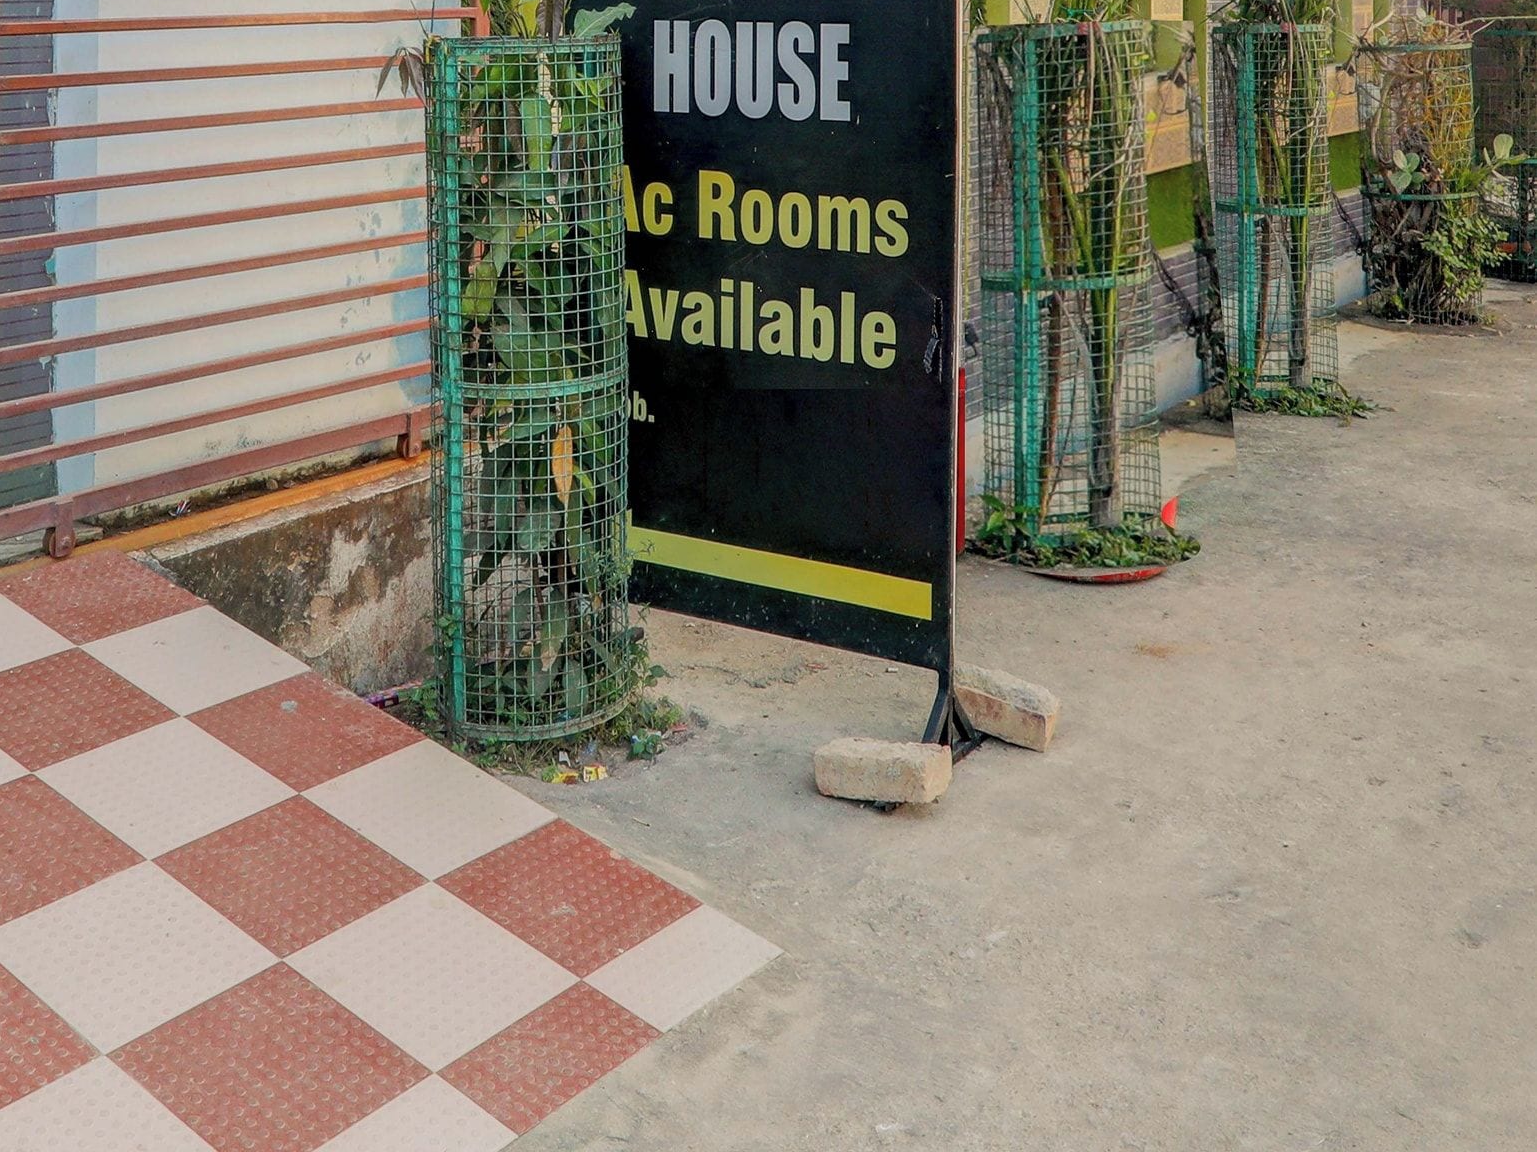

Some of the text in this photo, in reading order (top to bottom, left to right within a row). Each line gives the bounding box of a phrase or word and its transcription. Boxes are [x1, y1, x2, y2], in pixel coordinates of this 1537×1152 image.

[653, 19, 851, 122] HOUSE
[614, 165, 909, 258] Ac Rooms
[624, 269, 898, 369] Available
